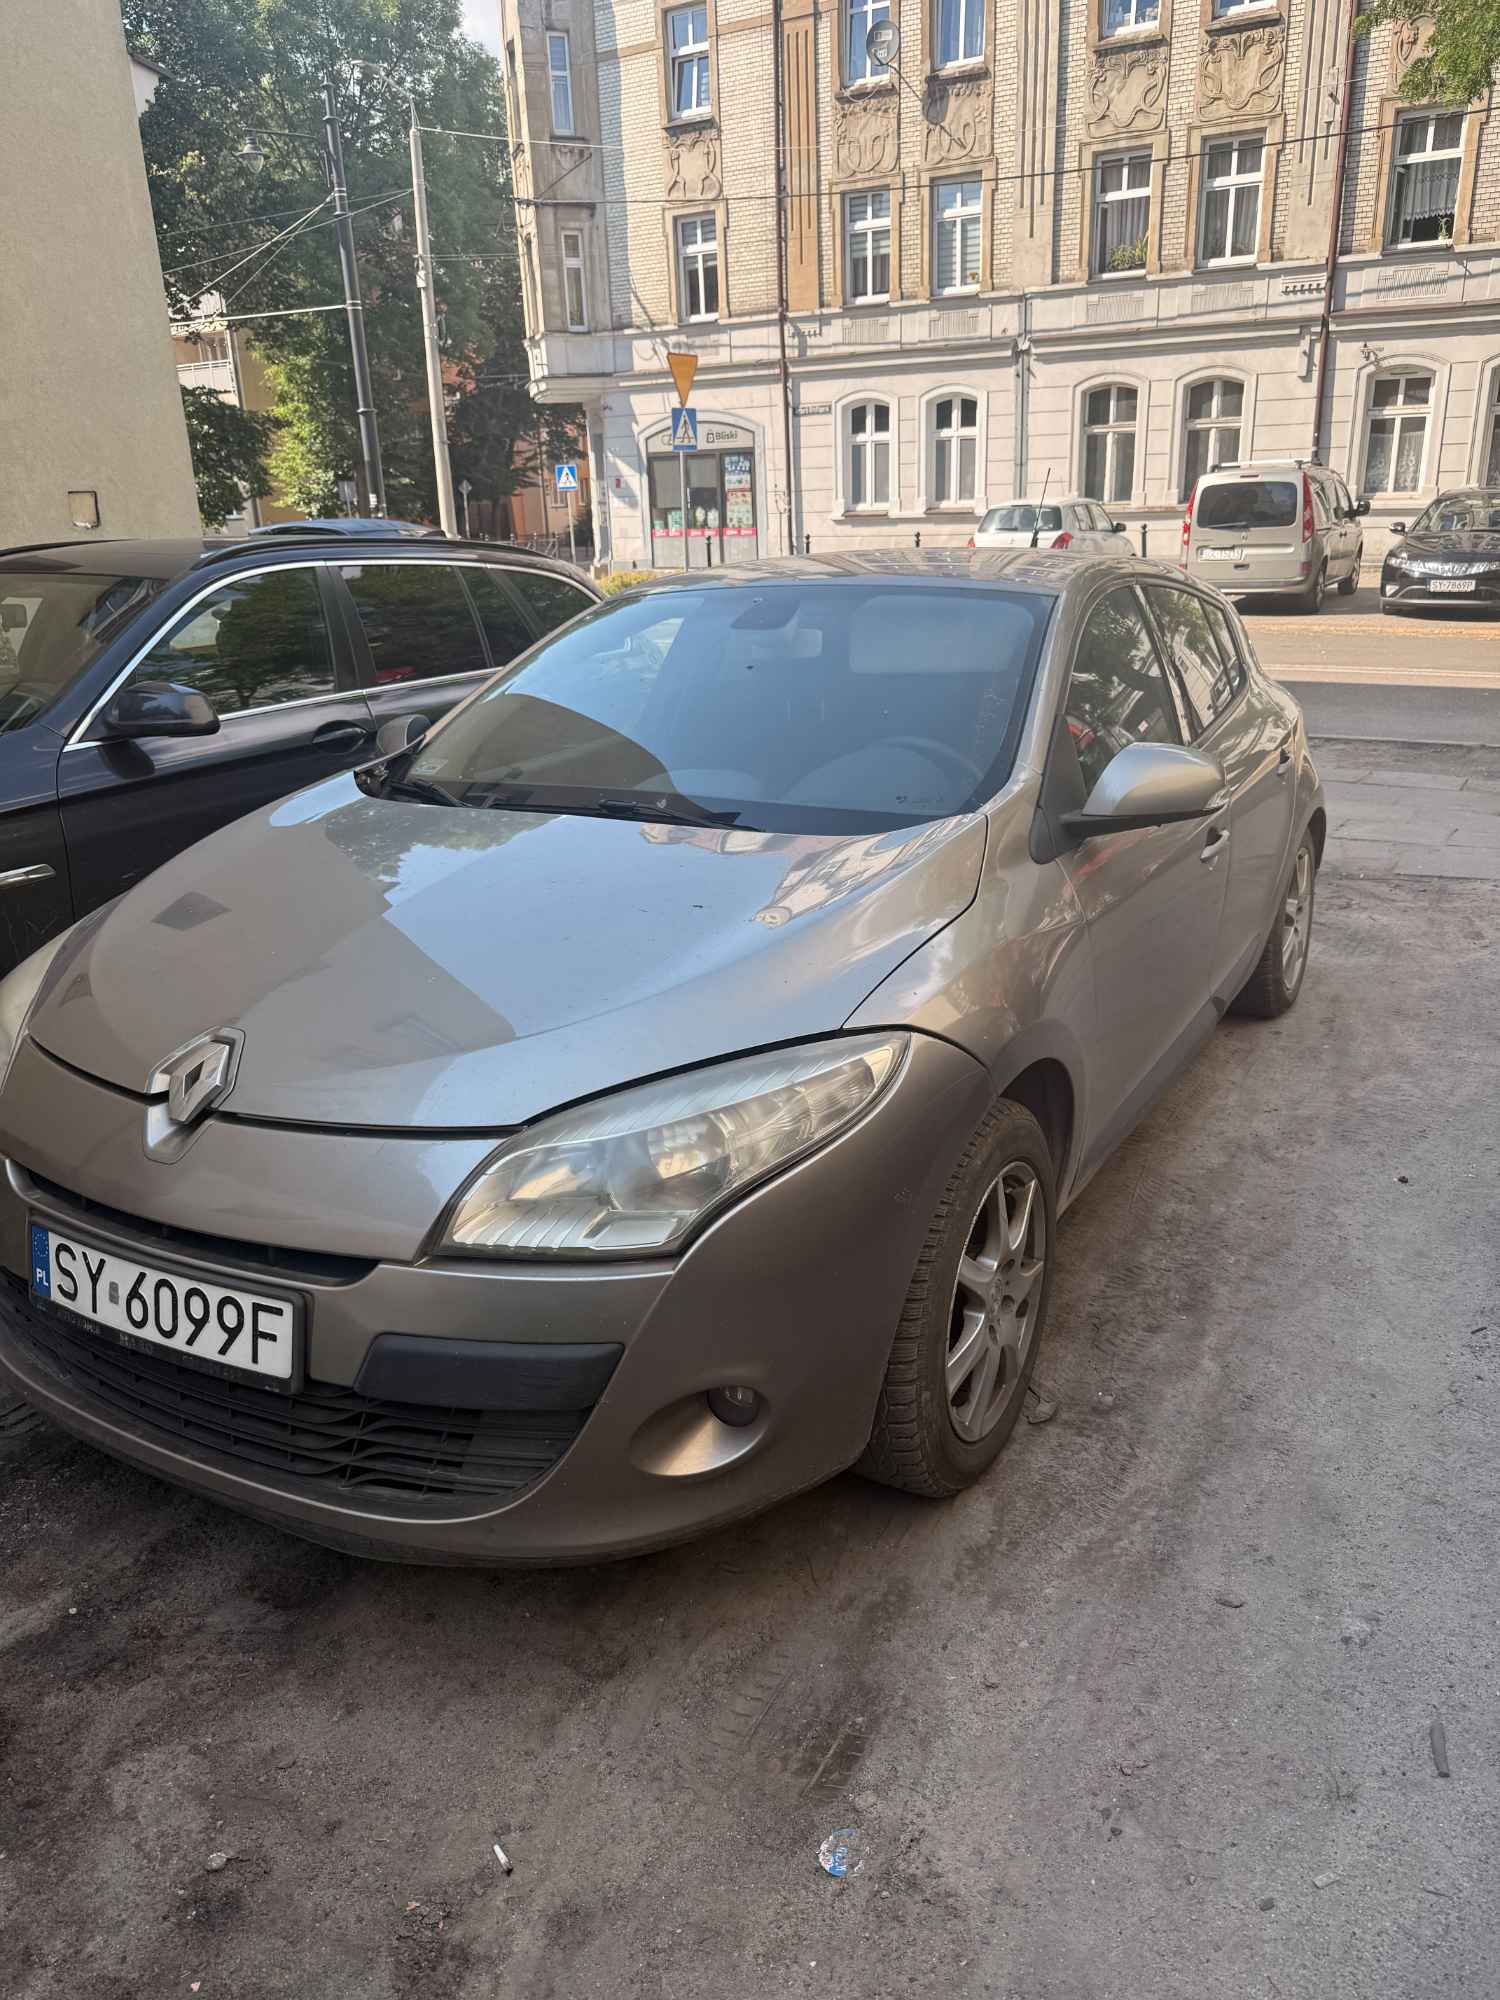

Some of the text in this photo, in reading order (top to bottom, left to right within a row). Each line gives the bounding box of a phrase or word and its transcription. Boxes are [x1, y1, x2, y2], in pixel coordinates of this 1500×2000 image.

[36, 1268, 49, 1287] PL
[55, 1242, 284, 1365] SY 6099F
